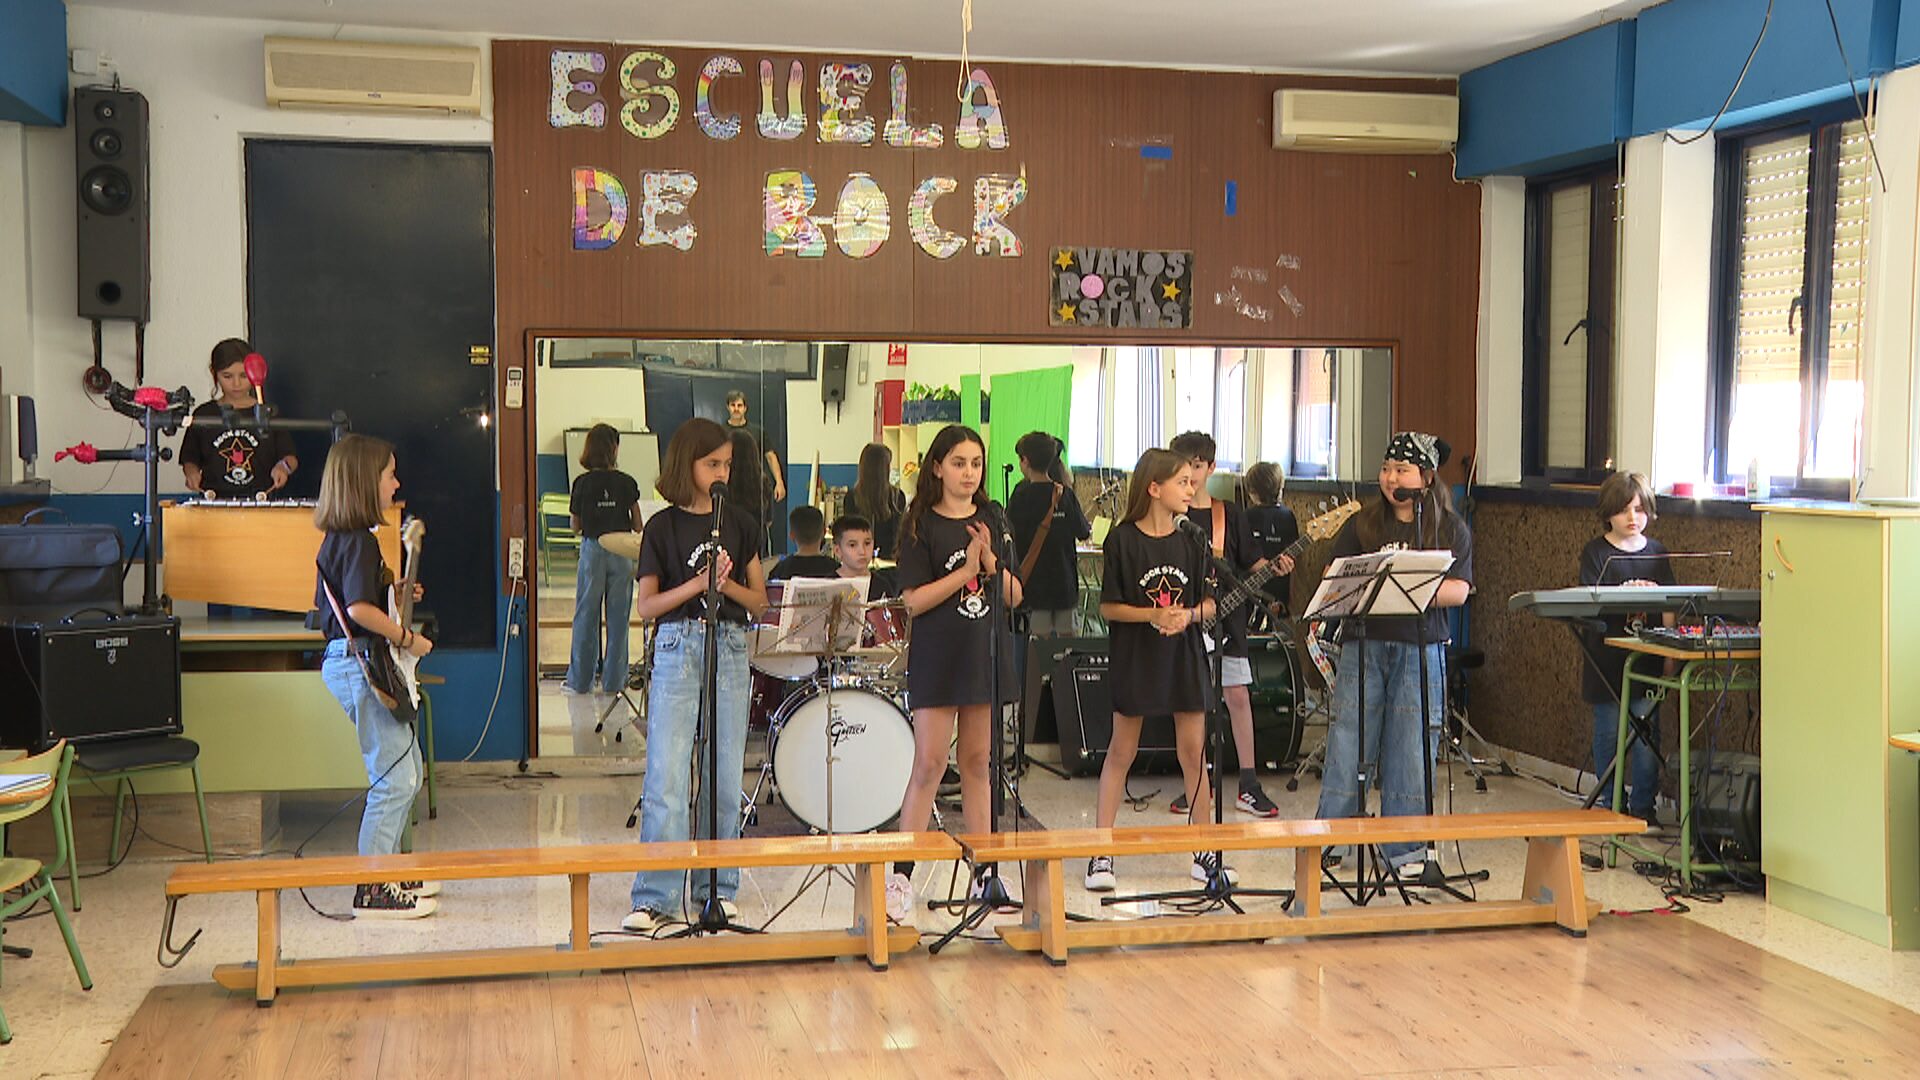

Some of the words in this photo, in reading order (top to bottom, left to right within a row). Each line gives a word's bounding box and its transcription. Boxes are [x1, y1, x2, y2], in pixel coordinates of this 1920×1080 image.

[549, 50, 1009, 150] ESCUELA
[572, 168, 699, 250] DE
[762, 168, 1028, 258] ROCK
[1077, 249, 1186, 279] VAMOS
[1059, 273, 1159, 300] ROCK
[1079, 299, 1183, 329] STARS
[944, 549, 966, 571] ROCK
[1139, 566, 1161, 587] ROCK
[1161, 565, 1189, 585] STARS
[96, 637, 129, 649] BOSS
